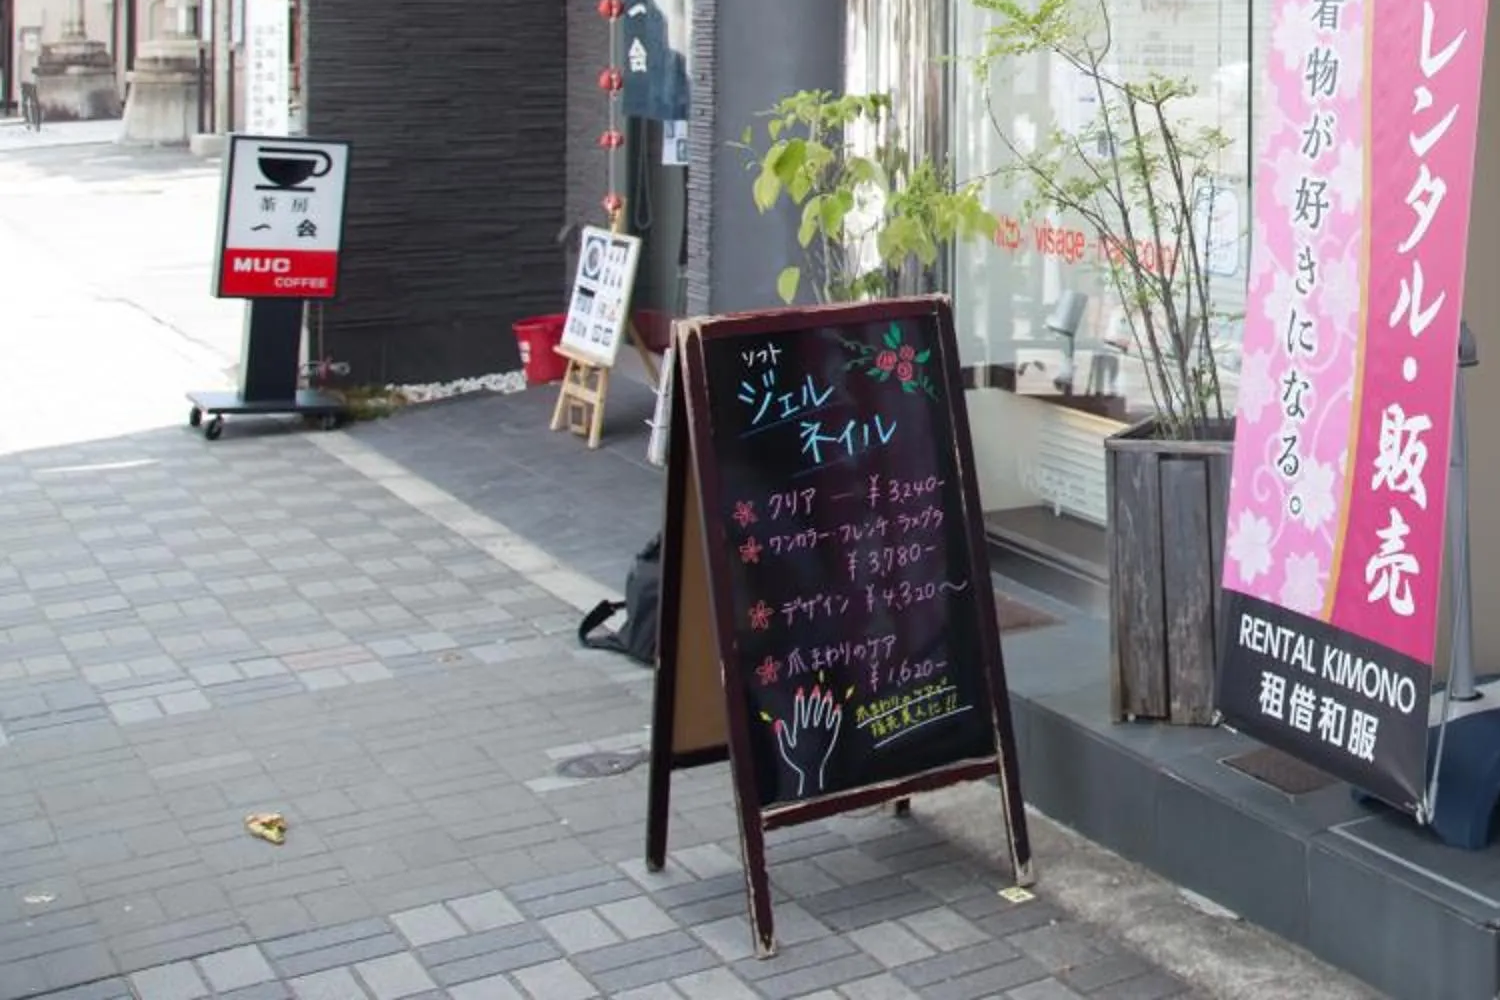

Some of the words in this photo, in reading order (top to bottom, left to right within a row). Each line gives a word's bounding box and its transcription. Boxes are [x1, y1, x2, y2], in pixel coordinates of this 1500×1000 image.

[233, 257, 291, 273] MUC
[274, 276, 328, 289] COFFEE
[741, 341, 782, 368] ソフト
[737, 369, 835, 425] ジェル
[799, 413, 898, 464] ネイル
[768, 486, 817, 520] クリア
[781, 594, 850, 628] デザイン
[787, 634, 898, 678] 爪まわりのケア
[1239, 613, 1317, 674] RENTAL
[1321, 644, 1417, 714] KIMONO
[1259, 670, 1379, 763] 租借和服
